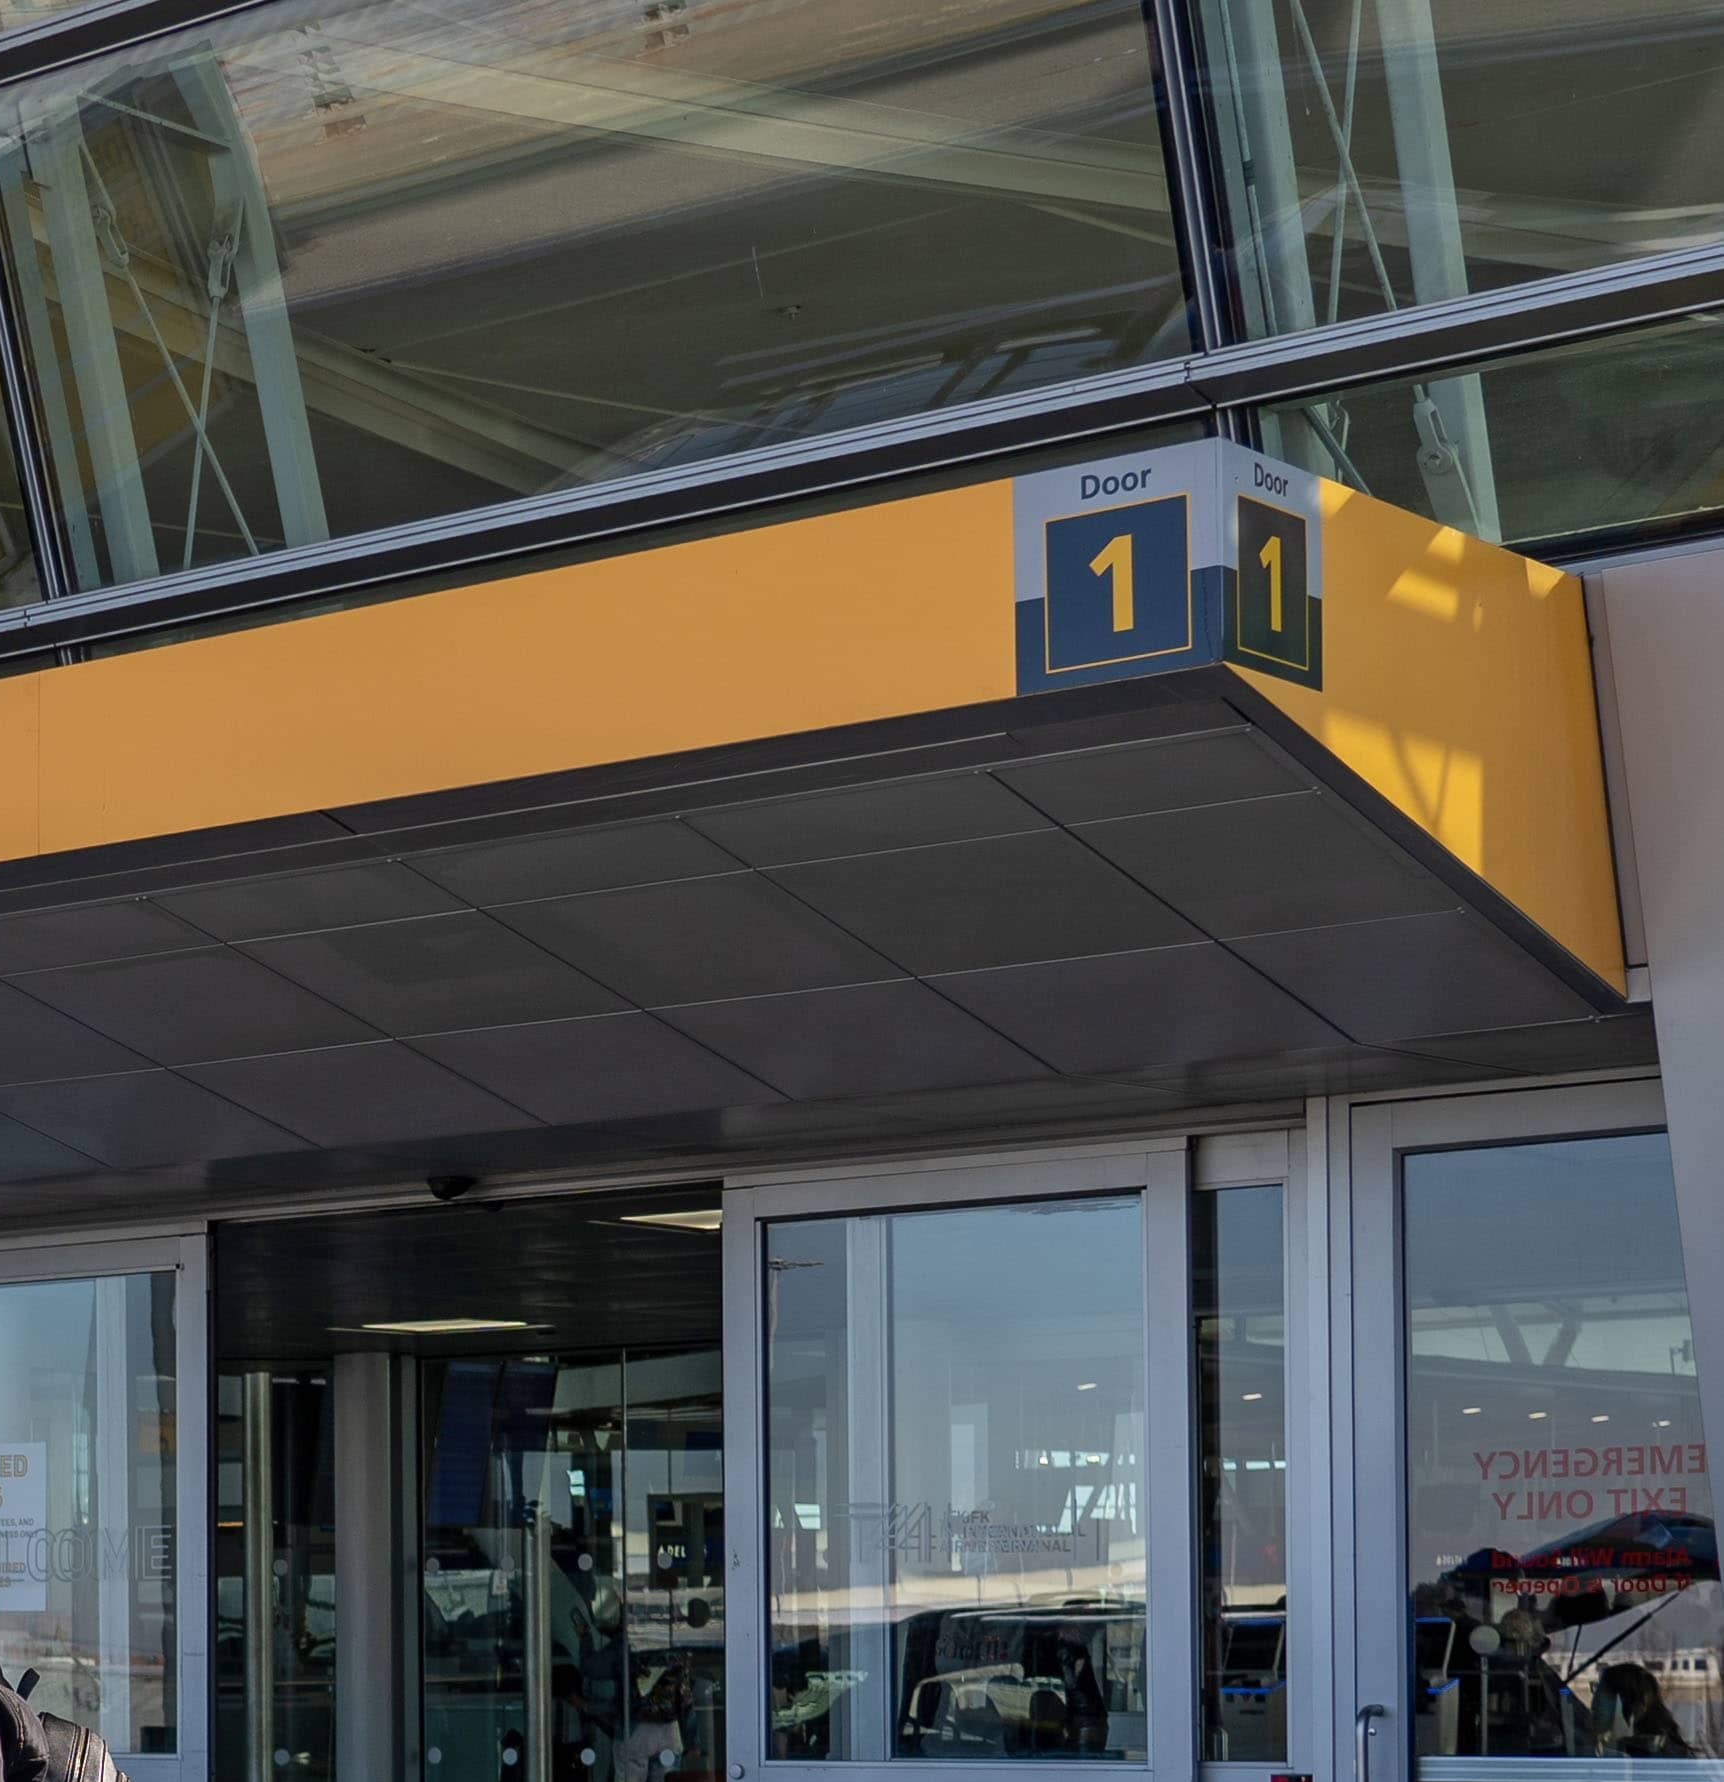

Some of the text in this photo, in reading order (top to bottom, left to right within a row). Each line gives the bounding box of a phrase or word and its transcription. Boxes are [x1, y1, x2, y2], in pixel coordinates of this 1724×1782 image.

[1080, 467, 1152, 500] Door
[1253, 461, 1289, 498] Door
[1088, 533, 1135, 633] 1
[1258, 535, 1282, 633] 1
